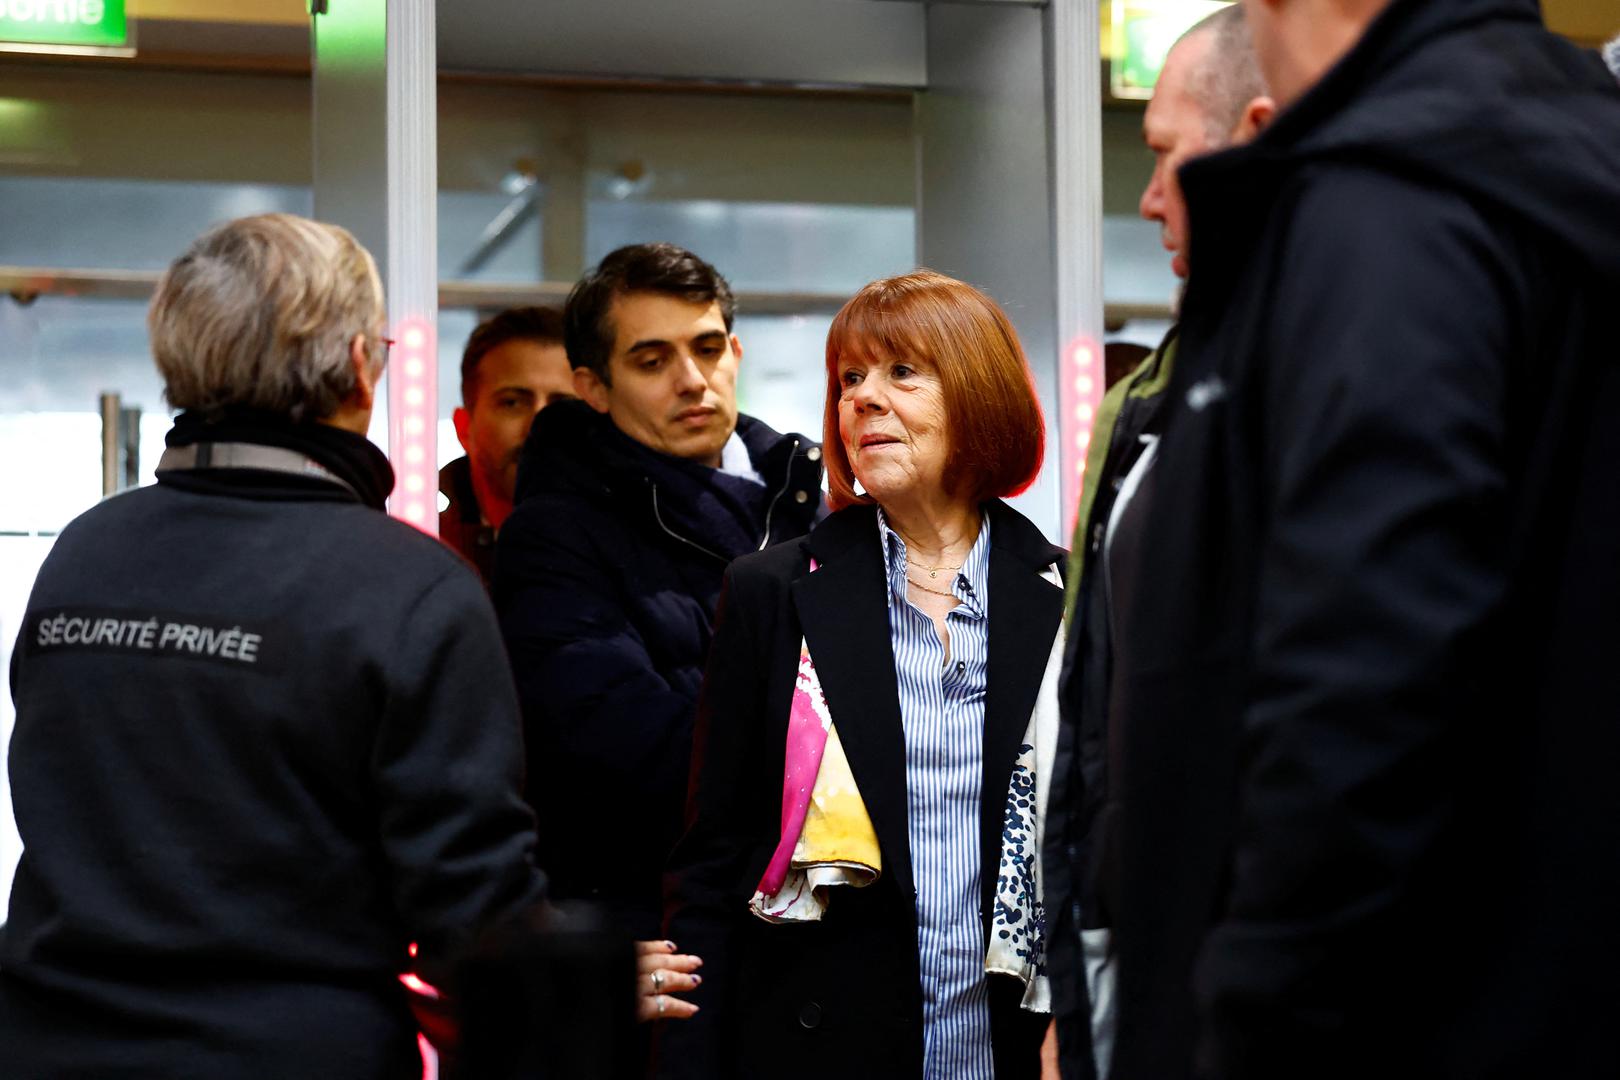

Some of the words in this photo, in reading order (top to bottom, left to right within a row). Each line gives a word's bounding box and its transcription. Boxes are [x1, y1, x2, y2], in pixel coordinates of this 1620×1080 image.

[0, 0, 104, 25] ortie
[36, 613, 159, 648] SÉCURITÉ
[158, 622, 262, 663] PRIVÉE
